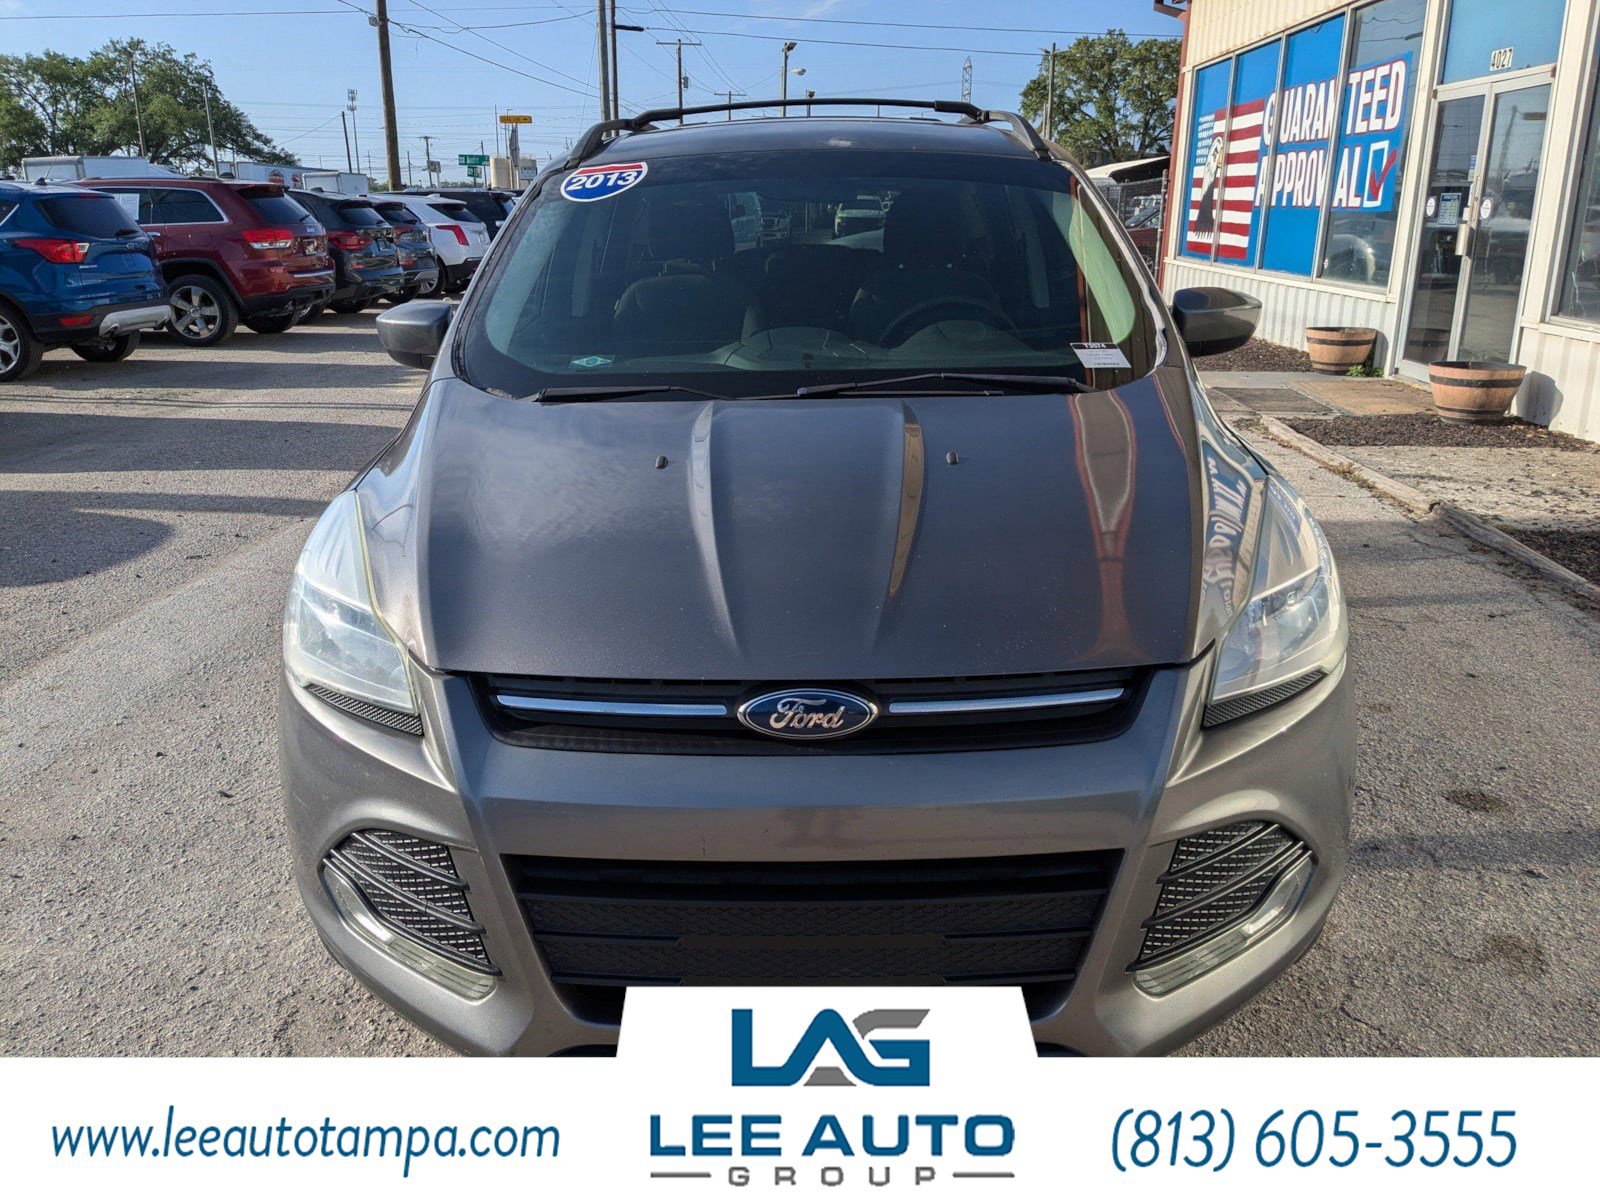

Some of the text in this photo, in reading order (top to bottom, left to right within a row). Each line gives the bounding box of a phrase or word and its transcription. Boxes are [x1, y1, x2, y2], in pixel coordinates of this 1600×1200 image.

[1491, 49, 1513, 69] 4027
[565, 171, 638, 192] 2013
[769, 698, 846, 729] Ford
